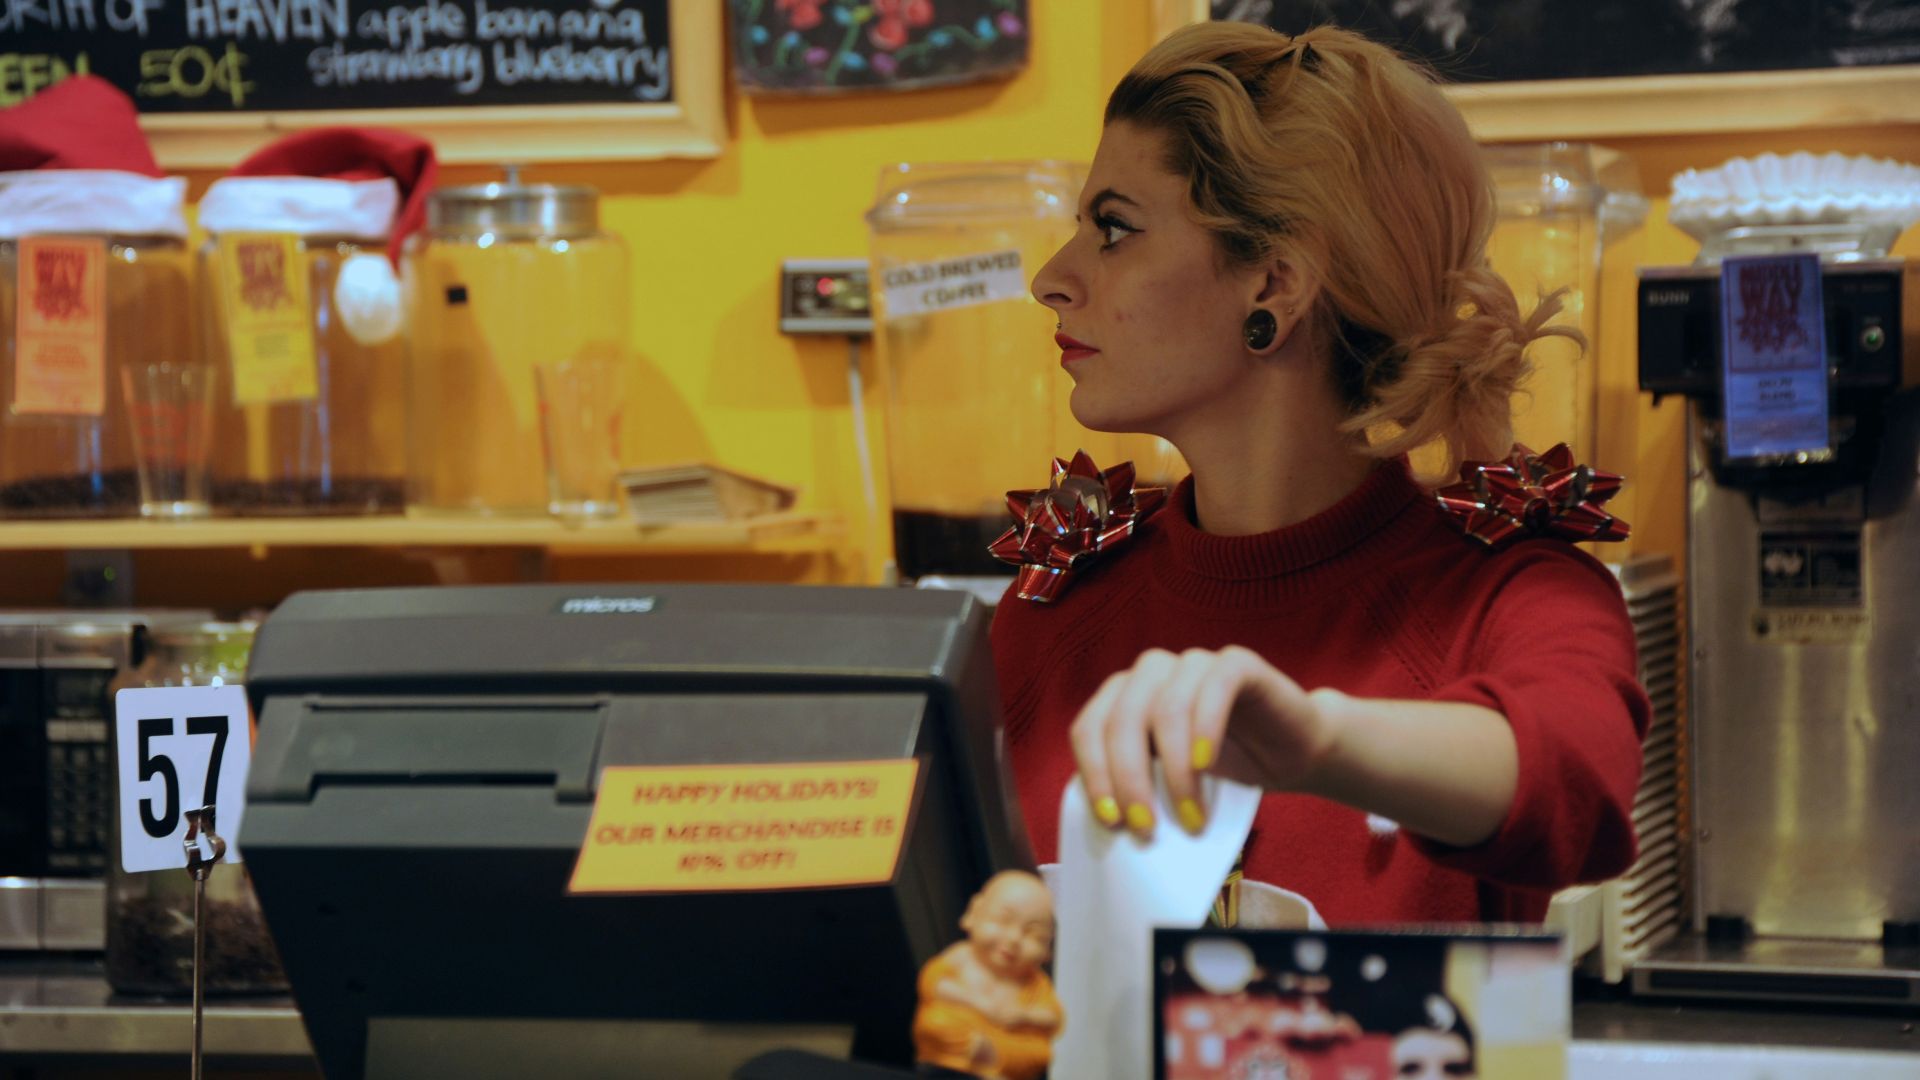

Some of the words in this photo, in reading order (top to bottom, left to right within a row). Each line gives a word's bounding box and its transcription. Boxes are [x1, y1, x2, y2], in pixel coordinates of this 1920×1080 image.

[104, 0, 164, 37] OF
[185, 0, 348, 43] HEAVEN
[356, 0, 467, 48] apple
[474, 0, 646, 43] banana
[494, 40, 669, 101] blueberry
[886, 263, 935, 289] COLD
[938, 250, 1022, 279] BREWED
[1647, 290, 1690, 305] BUNN
[562, 595, 655, 614] micros
[137, 715, 229, 839] 57
[633, 780, 728, 806] HAPPY
[595, 823, 656, 846] OUR
[662, 817, 863, 845] MERCHANDISE
[872, 815, 896, 837] IS
